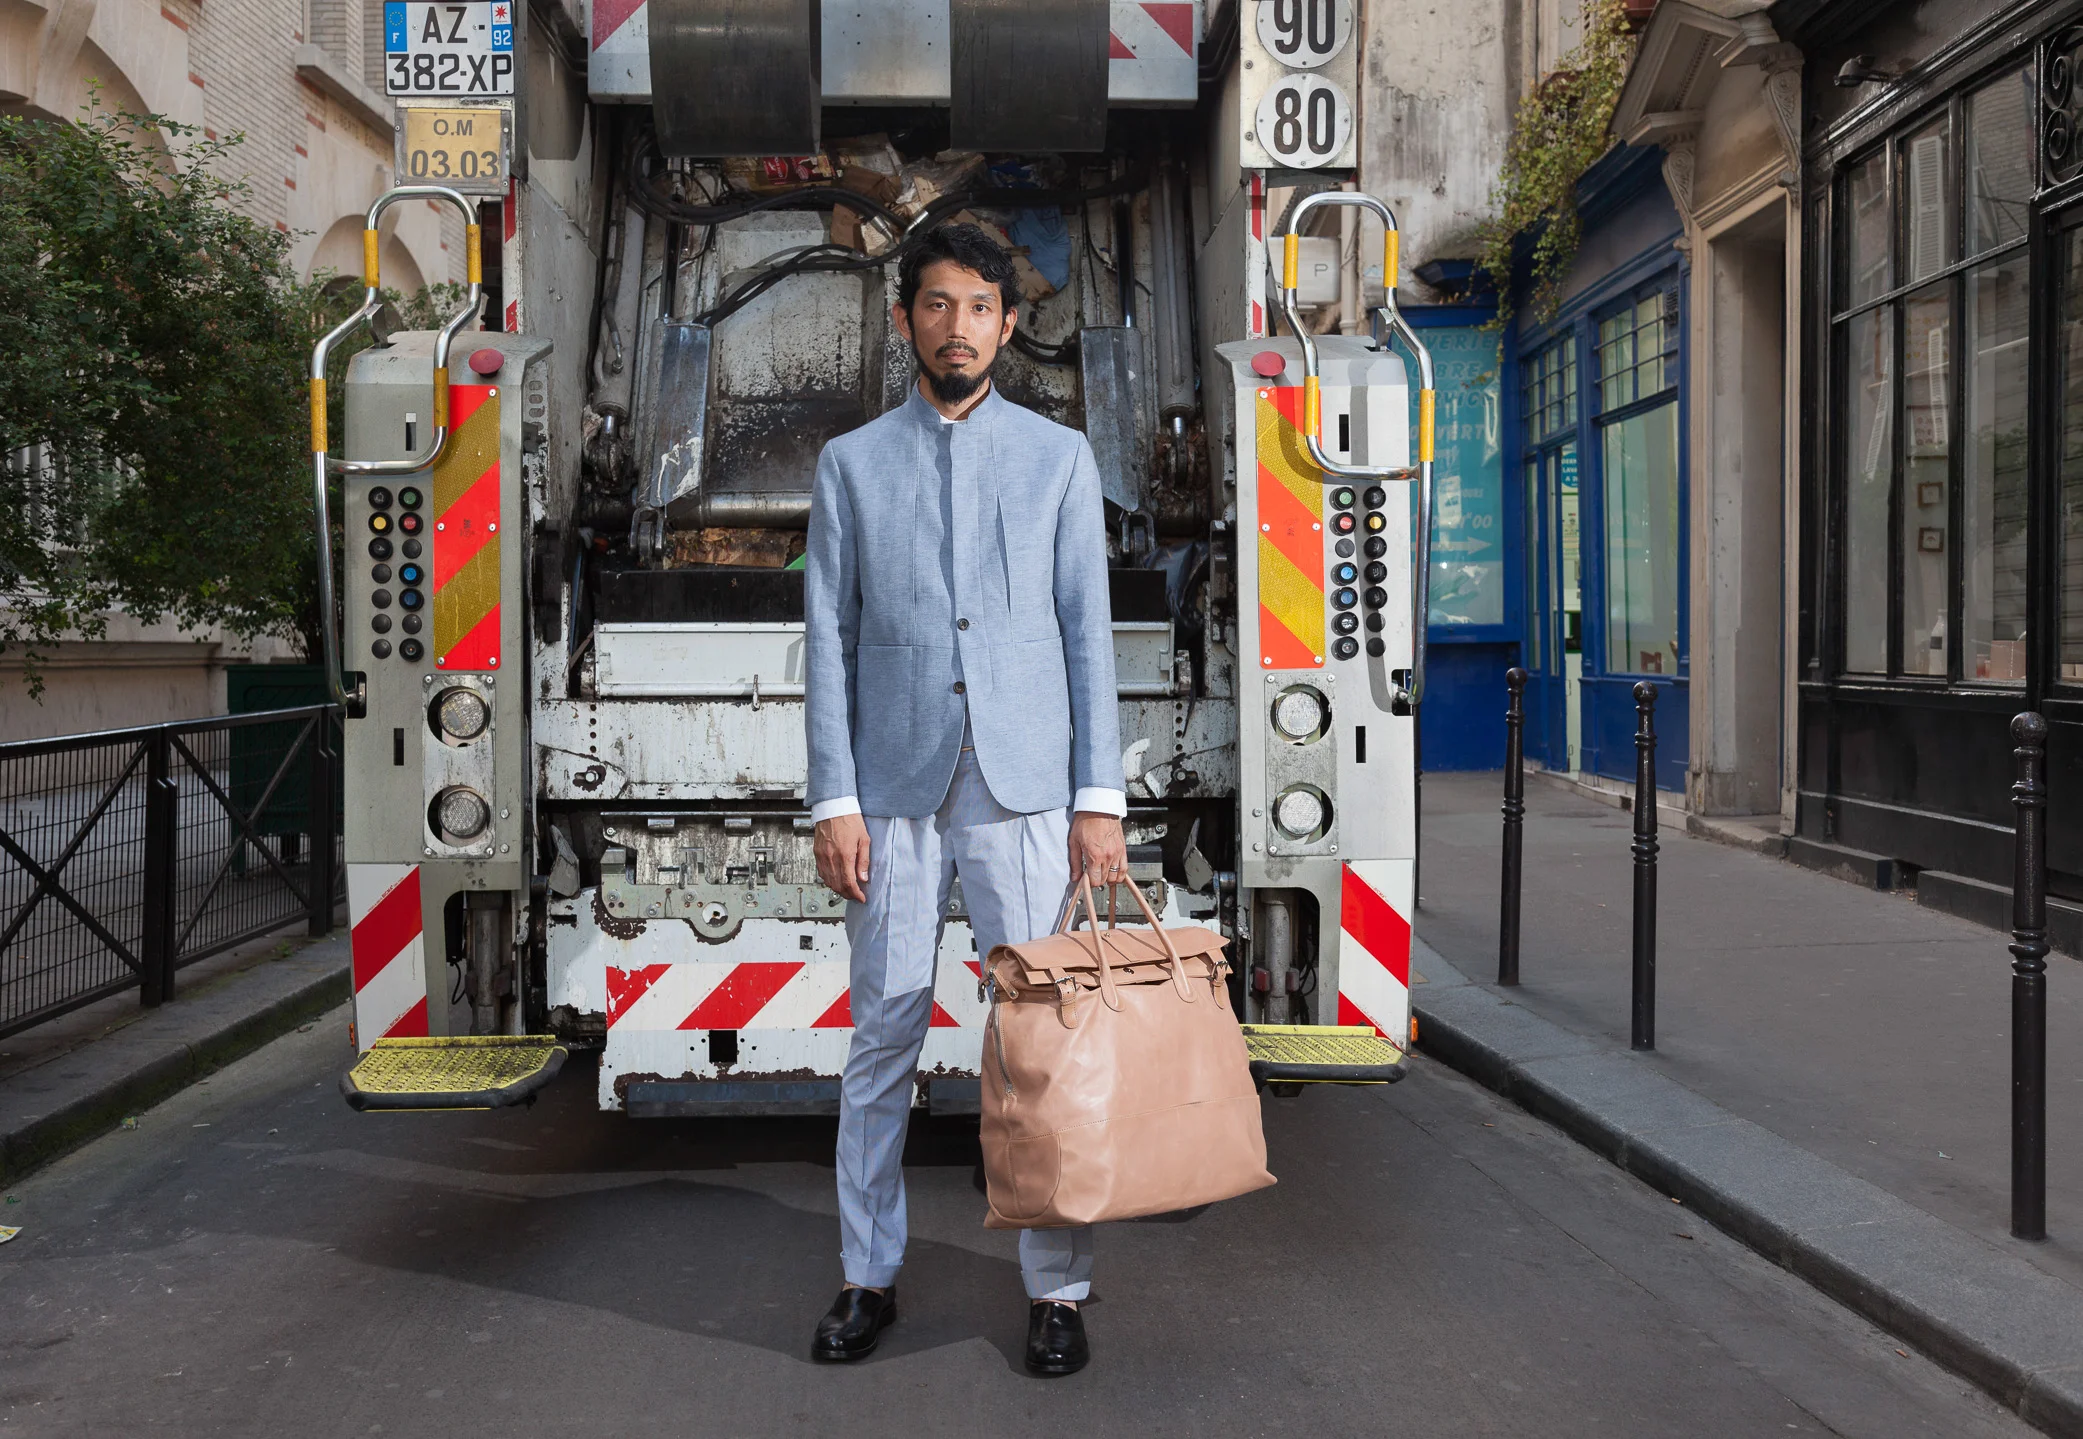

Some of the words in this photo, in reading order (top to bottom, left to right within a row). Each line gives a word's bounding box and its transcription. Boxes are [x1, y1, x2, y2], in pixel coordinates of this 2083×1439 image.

[1274, 0, 1335, 55] 90
[392, 32, 400, 44] F
[493, 29, 512, 46] 92
[388, 53, 512, 92] 382-XP
[1274, 87, 1336, 155] 80
[410, 149, 499, 178] 03.03
[1314, 263, 1329, 278] P
[1396, 332, 1496, 351] LVERIE
[1411, 360, 1481, 379] LBRE
[1410, 423, 1486, 440] OVERT
